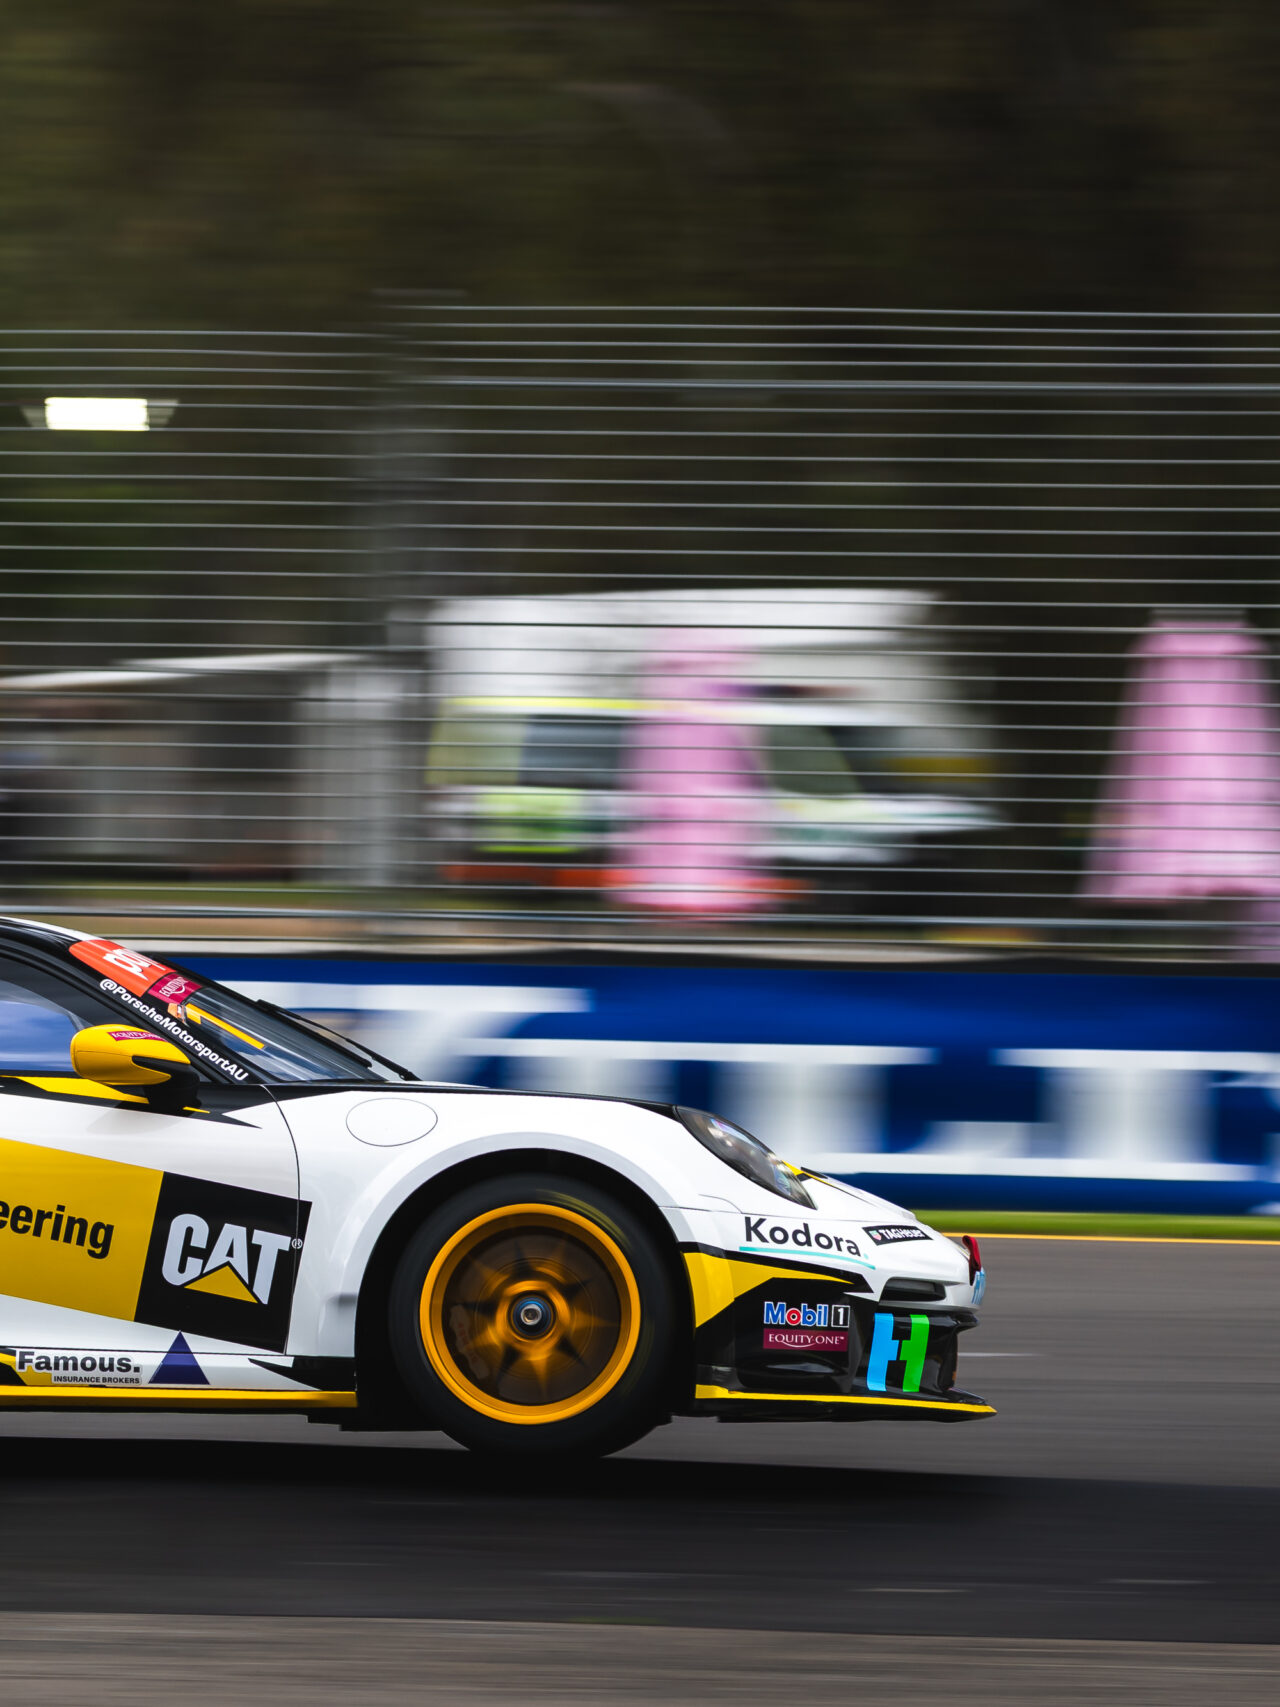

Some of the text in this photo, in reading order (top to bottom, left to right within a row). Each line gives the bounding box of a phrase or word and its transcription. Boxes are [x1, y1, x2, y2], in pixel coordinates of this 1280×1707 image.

[99, 978, 250, 1082] @PorscheMotorsportAU
[161, 1213, 292, 1305] CAT
[763, 1301, 829, 1328] Mobil
[769, 1334, 839, 1347] EQUITY ONE
[18, 1351, 141, 1373] Famous.
[54, 1376, 140, 1384] INSURANCE BROKERS
